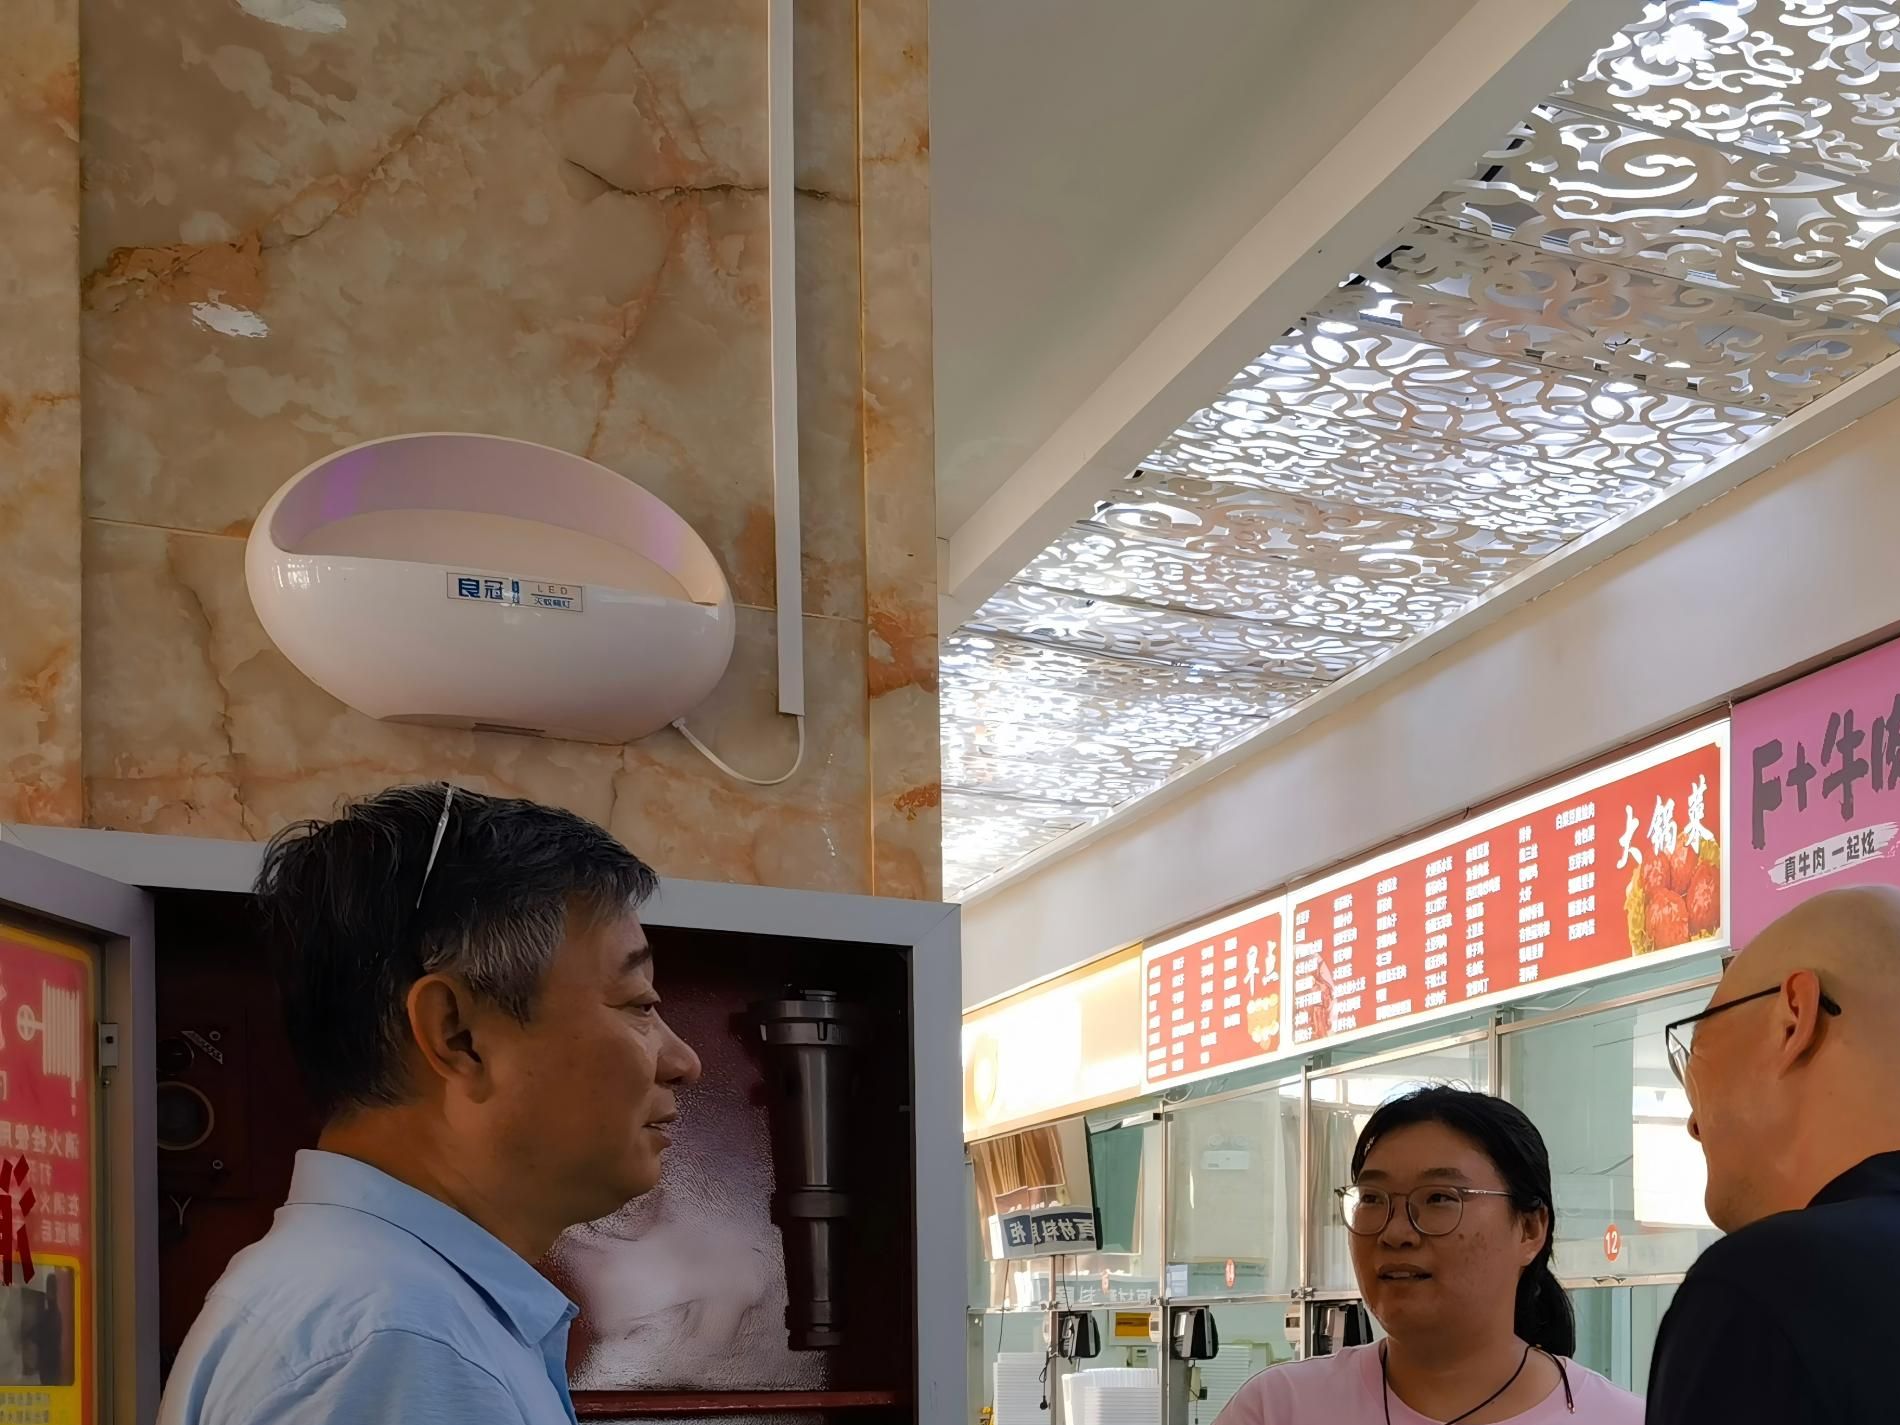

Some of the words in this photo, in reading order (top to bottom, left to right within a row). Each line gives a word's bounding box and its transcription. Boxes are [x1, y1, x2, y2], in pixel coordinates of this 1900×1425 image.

[458, 577, 503, 601] 良冠
[537, 584, 568, 595] LED
[1617, 775, 1717, 872] 大锅菜
[1605, 1230, 1618, 1254] 12
